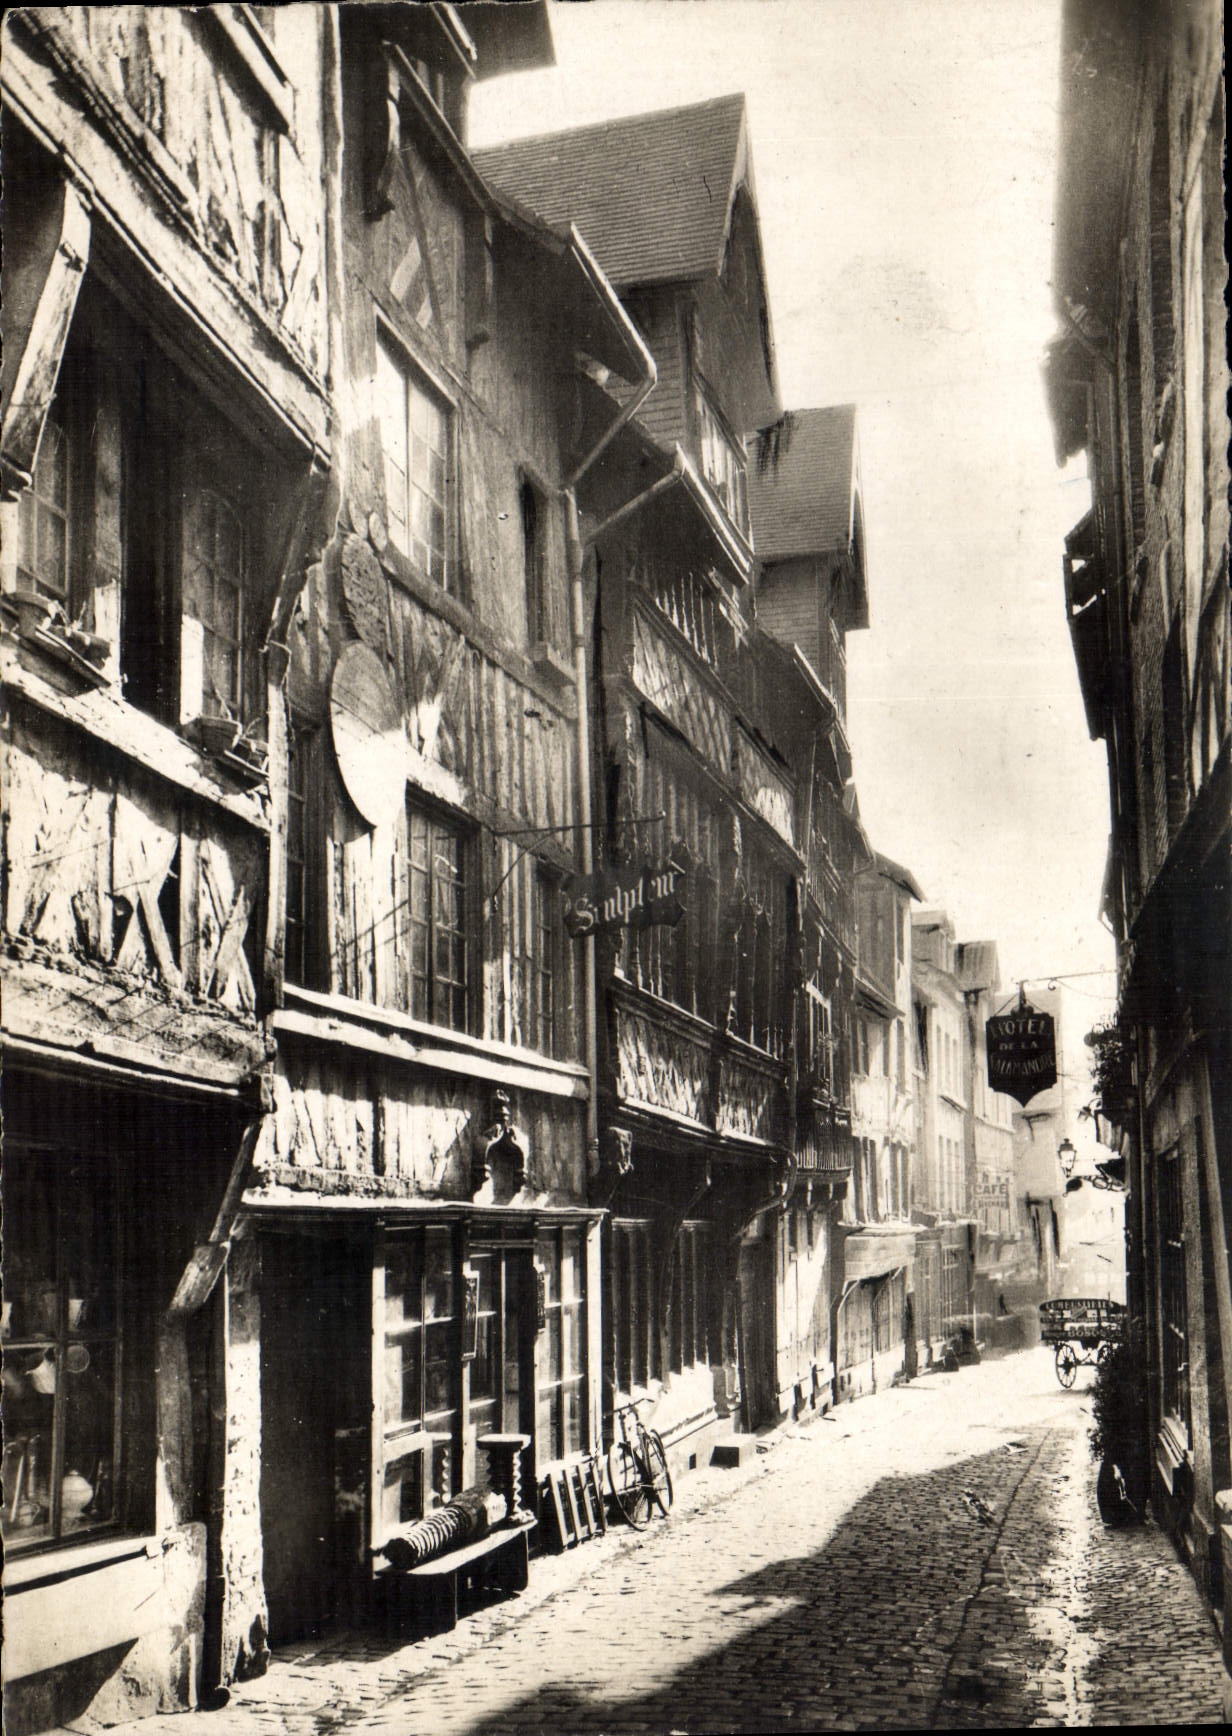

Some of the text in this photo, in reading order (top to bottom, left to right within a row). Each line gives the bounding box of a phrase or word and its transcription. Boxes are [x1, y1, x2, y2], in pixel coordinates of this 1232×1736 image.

[991, 1019, 1050, 1038] HOTEL
[999, 1041, 1039, 1051] DE LA
